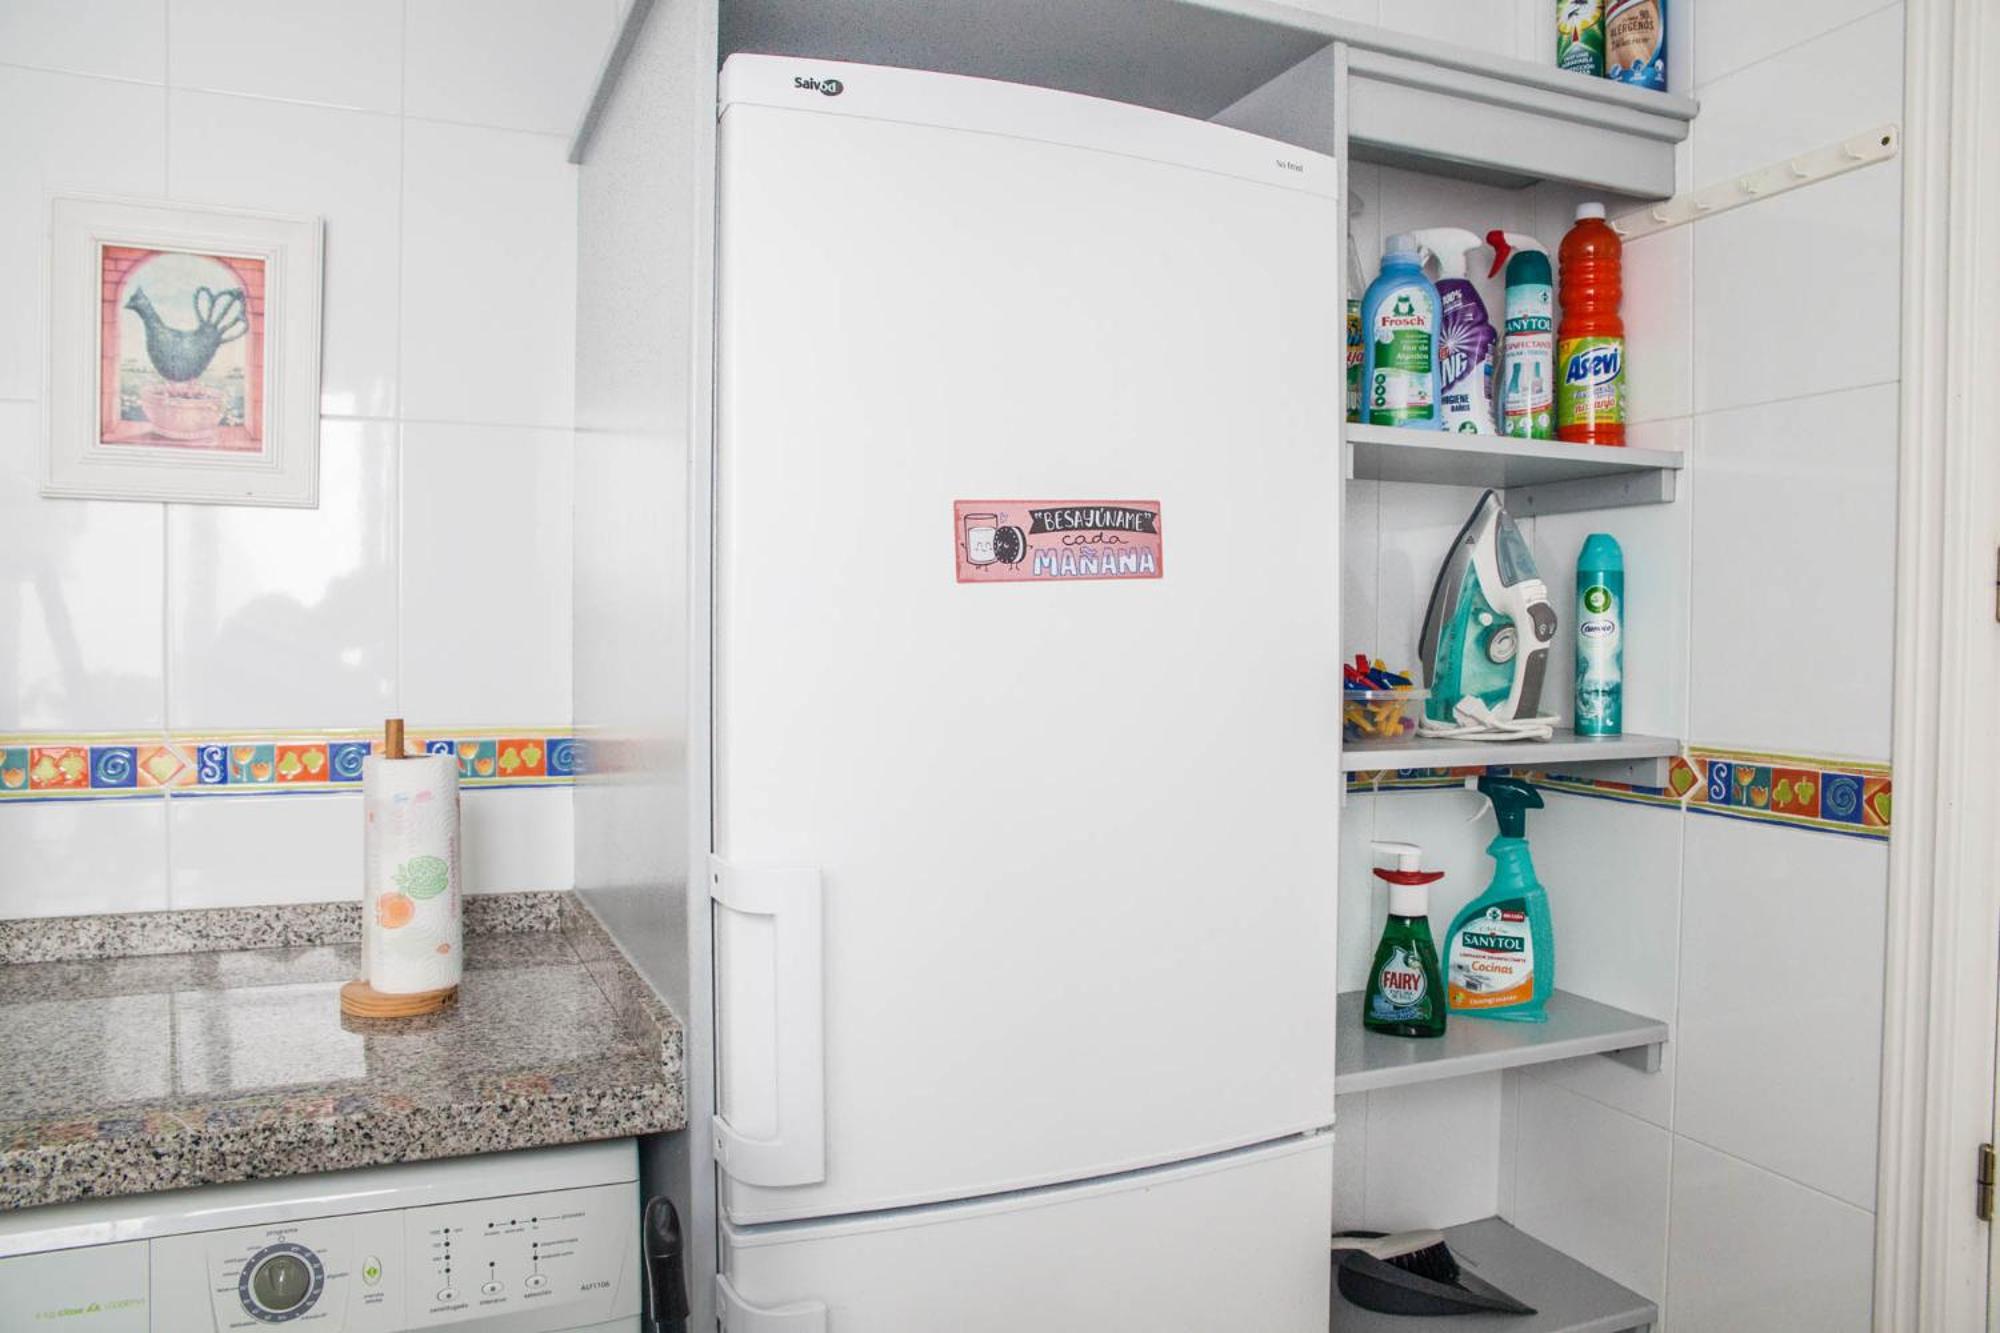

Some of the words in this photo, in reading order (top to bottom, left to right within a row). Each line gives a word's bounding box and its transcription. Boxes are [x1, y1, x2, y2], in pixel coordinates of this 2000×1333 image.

[794, 77, 844, 96] Saivod
[1381, 316, 1425, 327] Frosch
[1566, 348, 1618, 384] Asevi
[1062, 532, 1128, 546] cada
[1032, 546, 1155, 576] MAÑANA
[1464, 934, 1522, 950] SANYTOL
[1471, 960, 1513, 975] Cocinas
[1383, 971, 1421, 991] FAIRY
